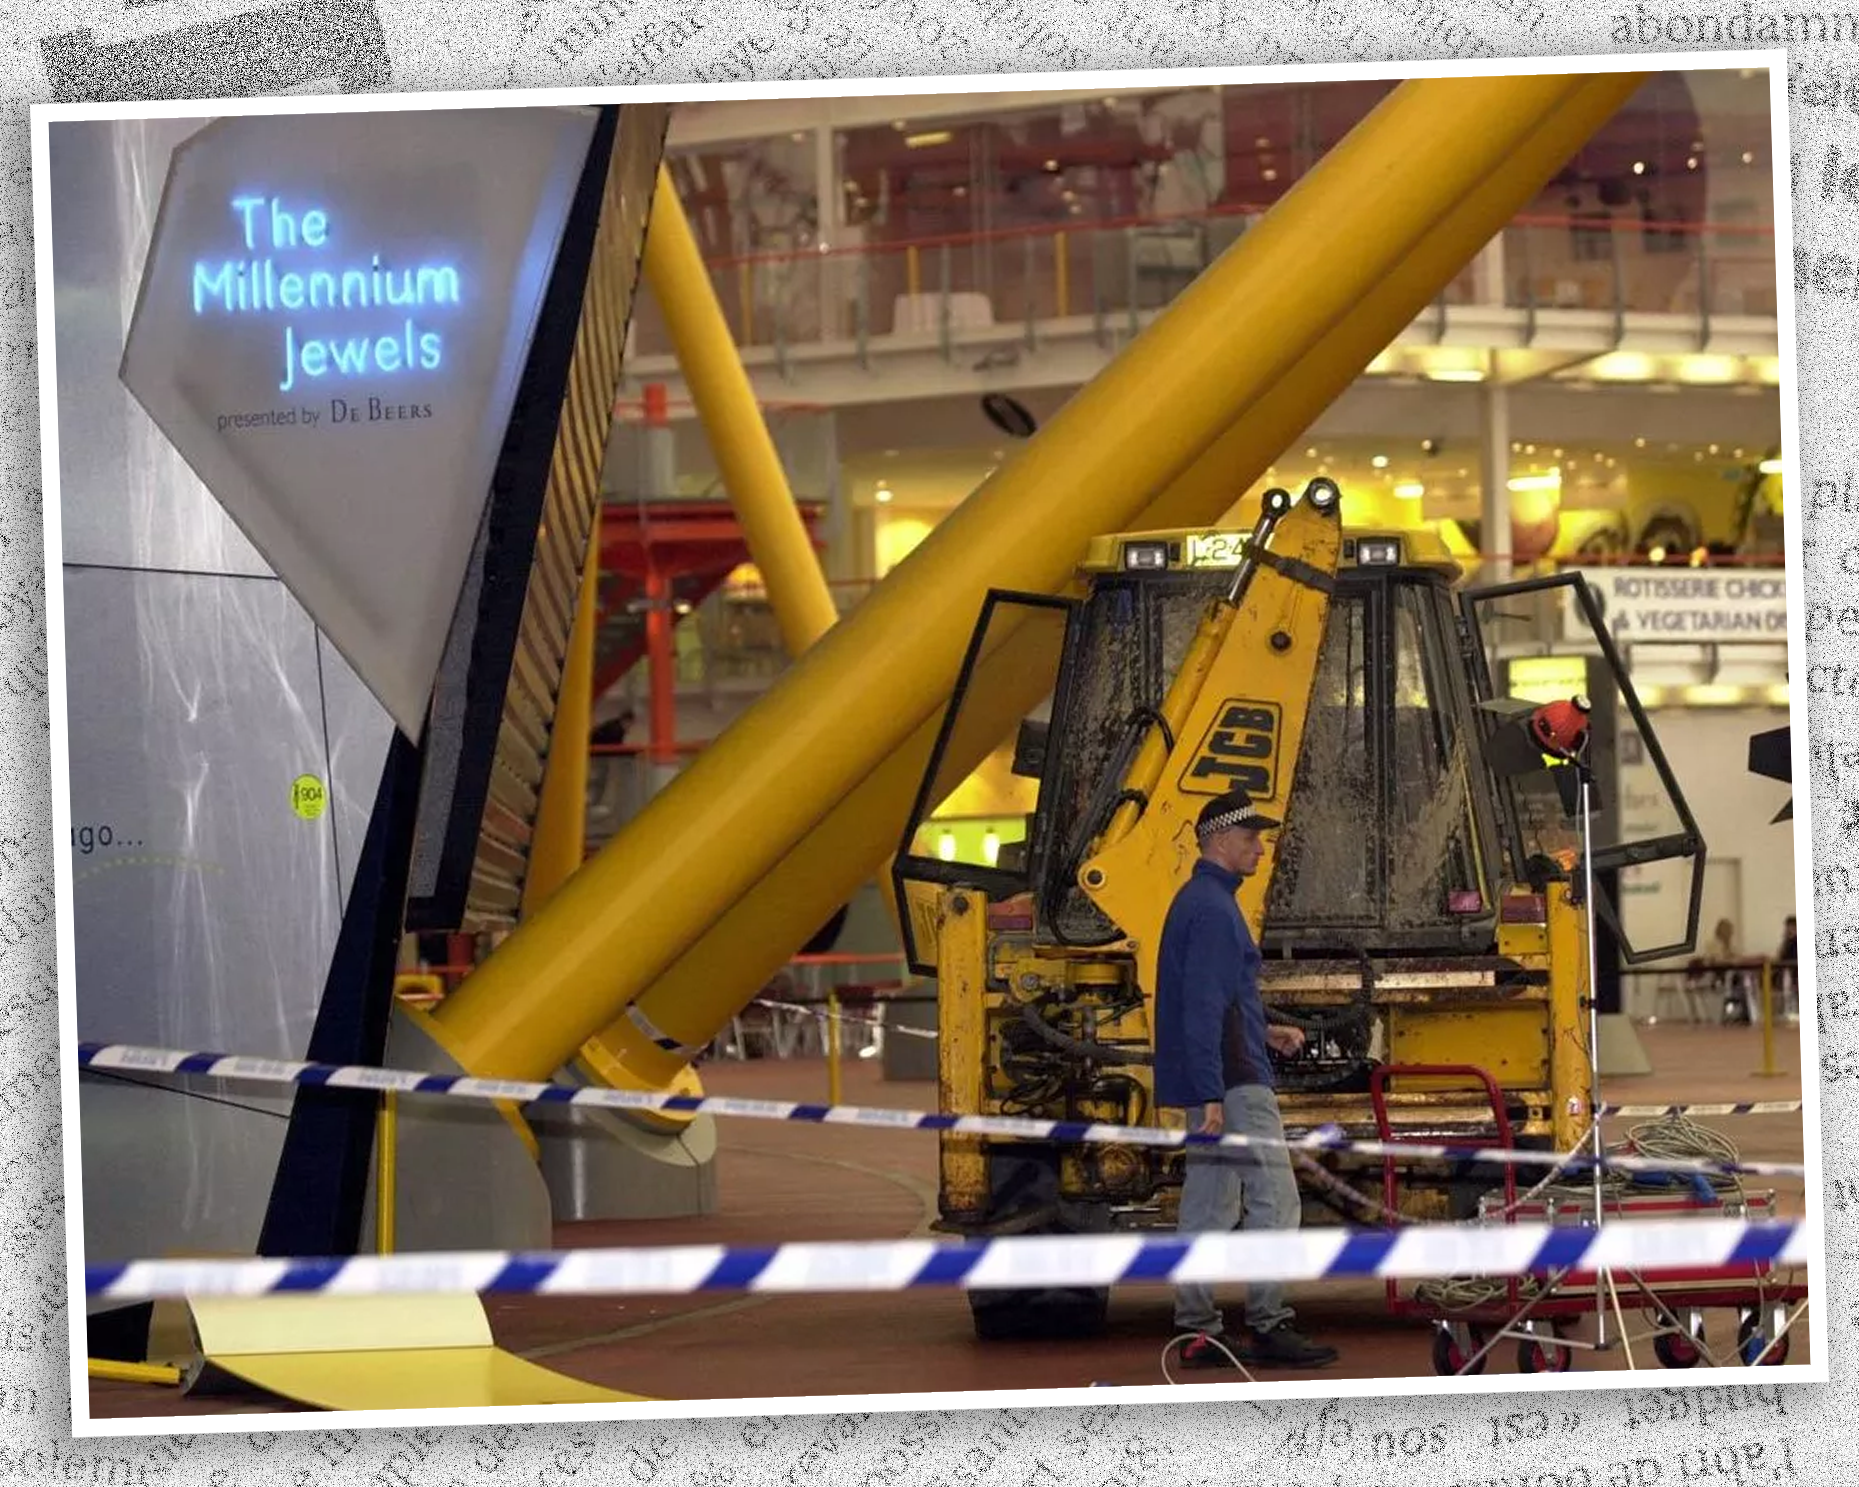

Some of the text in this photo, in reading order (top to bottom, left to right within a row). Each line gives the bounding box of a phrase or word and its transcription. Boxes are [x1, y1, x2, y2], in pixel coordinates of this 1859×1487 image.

[231, 197, 328, 249] The
[193, 254, 459, 316] Millennium
[279, 318, 441, 392] Jewels
[217, 408, 296, 432] presented
[301, 407, 320, 428] by
[1614, 577, 1719, 600] ROTISSERIE
[1636, 609, 1761, 631] VEGETARIAN
[1191, 706, 1275, 794] JCB
[300, 786, 323, 802] 904
